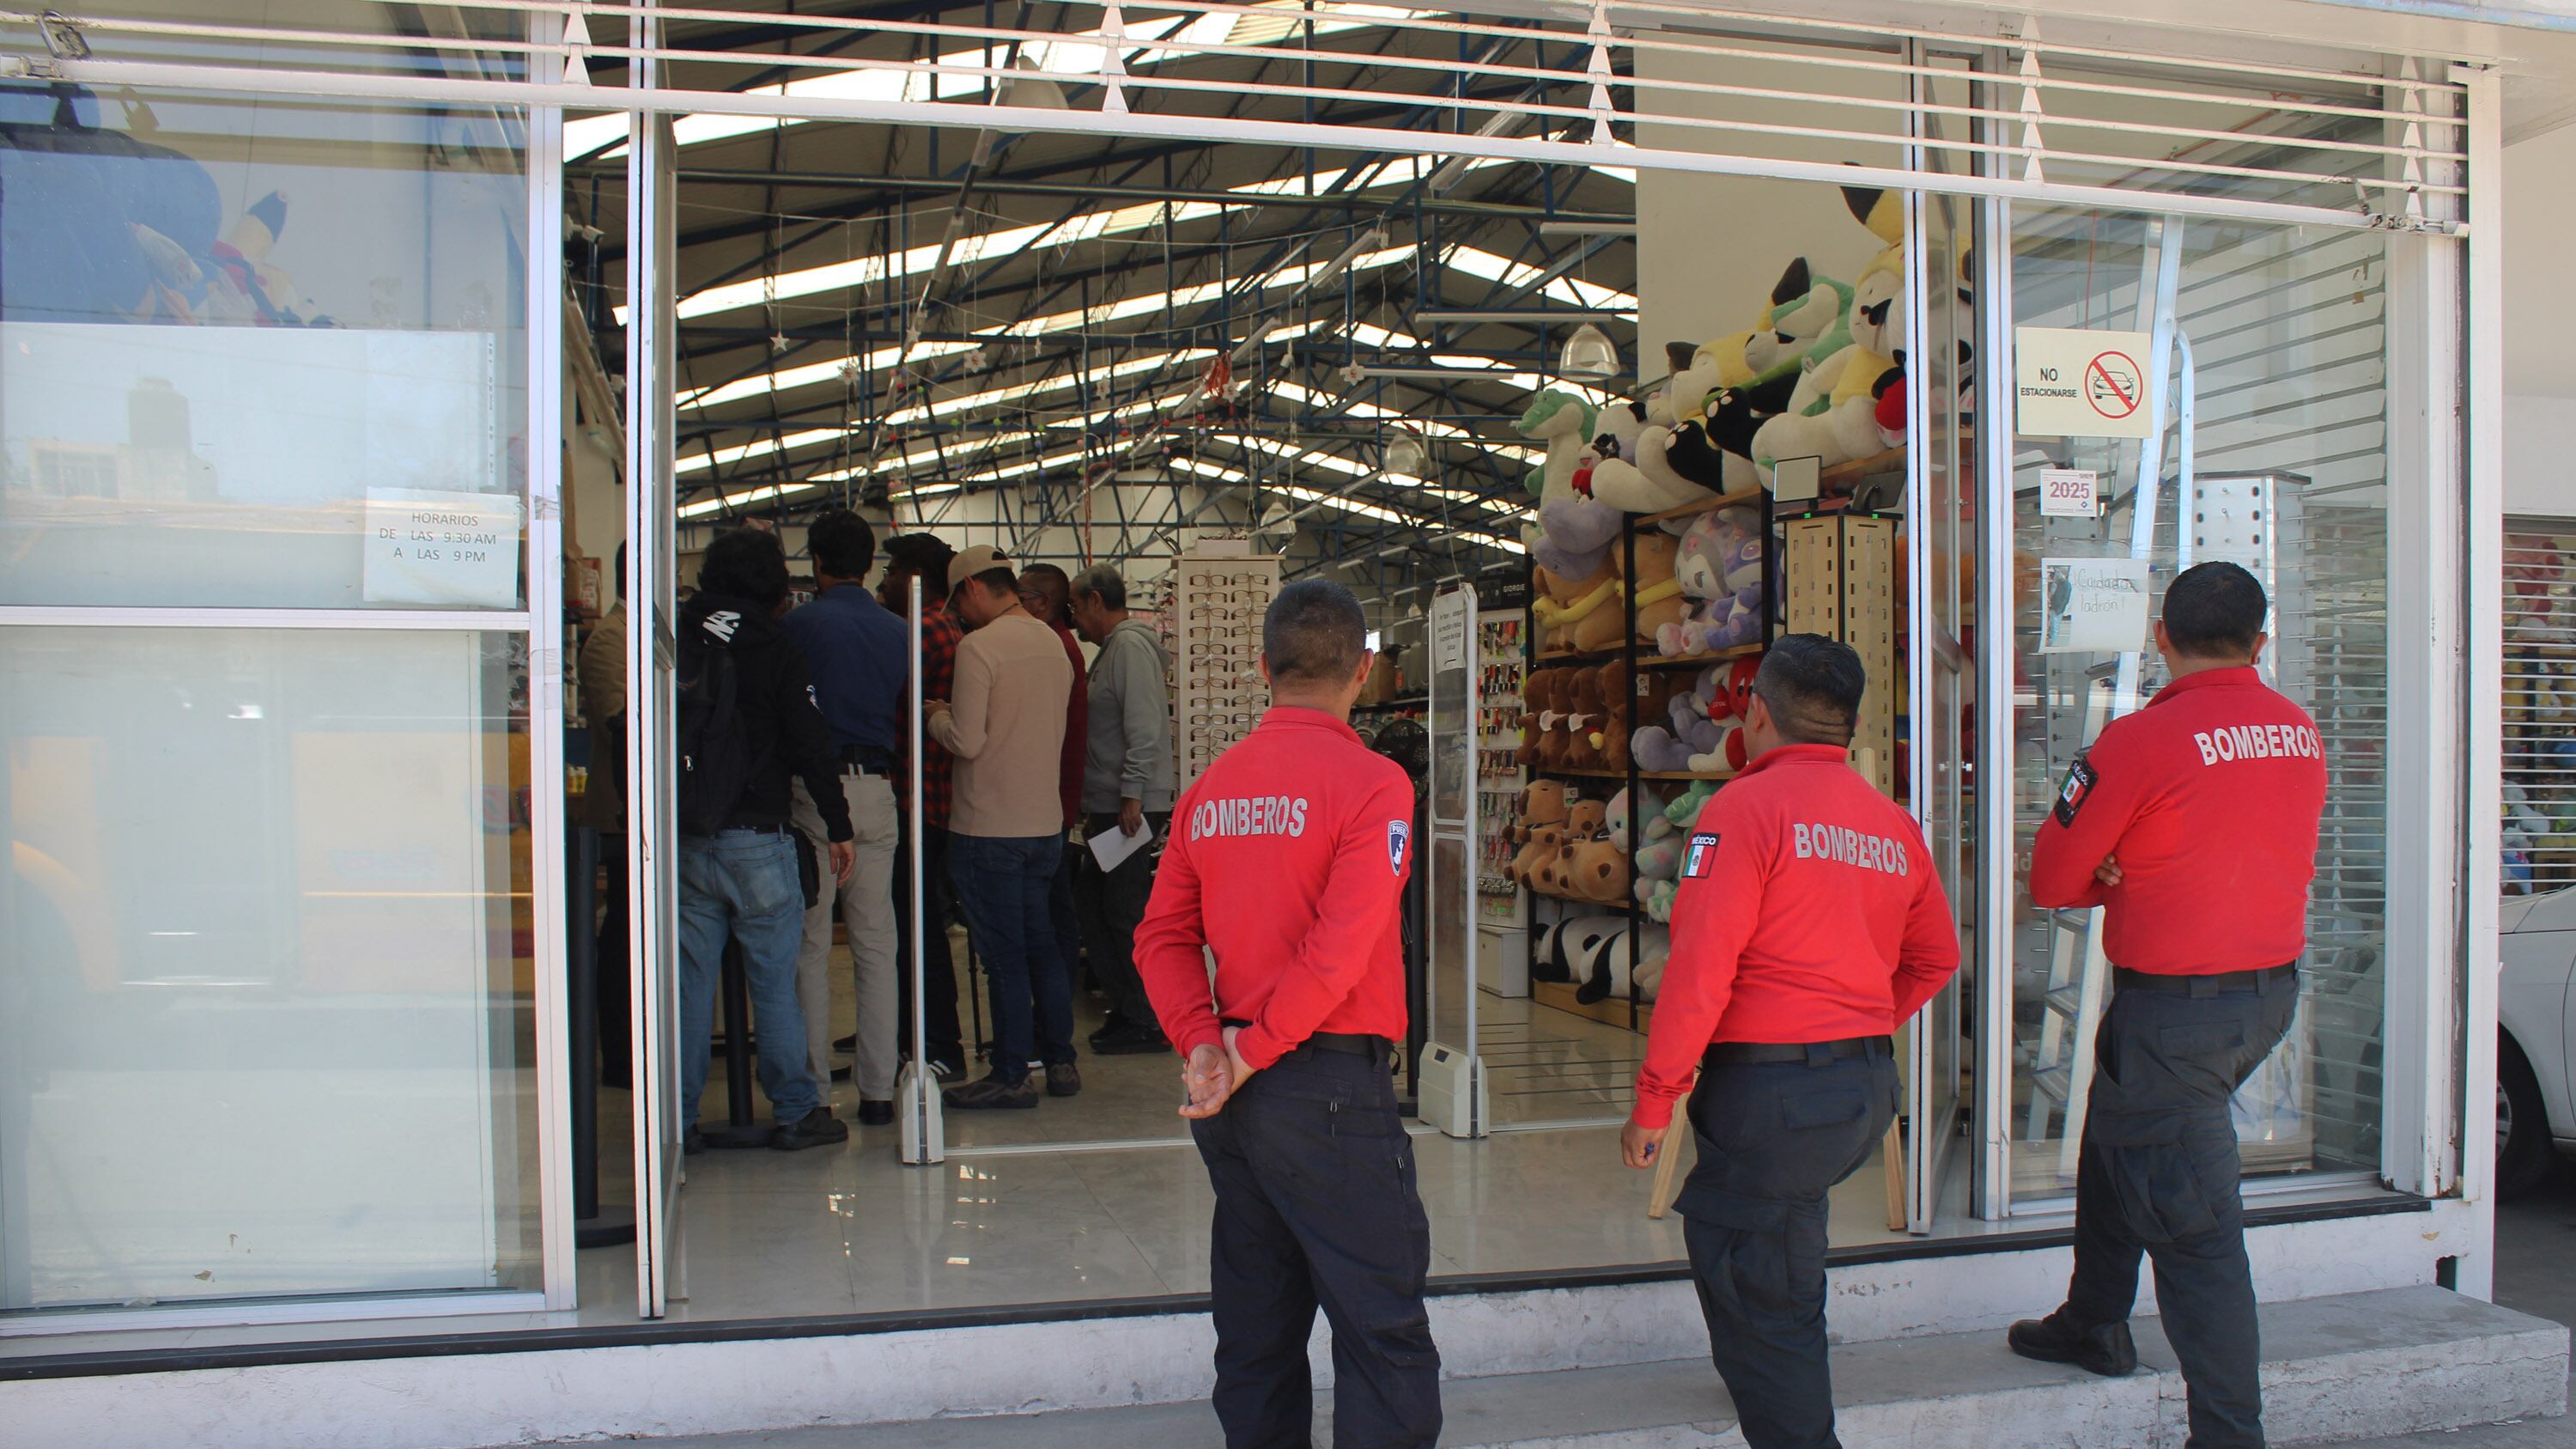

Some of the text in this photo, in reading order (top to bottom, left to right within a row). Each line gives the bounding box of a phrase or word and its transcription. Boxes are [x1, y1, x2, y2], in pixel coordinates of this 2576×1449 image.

[2039, 368, 2058, 381] NO
[2020, 387, 2077, 398] ESTACIONARSE
[2050, 481, 2089, 499] 2025
[412, 513, 478, 527] HORARIOS
[380, 527, 396, 539] DE
[410, 530, 434, 542] LAS
[474, 533, 496, 545] AM
[393, 547, 485, 563] A LAS 9 PM
[2193, 725, 2320, 766] BOMBEROS
[1191, 795, 1308, 842] BOMBEROS
[1793, 823, 1908, 876] BOMBEROS
